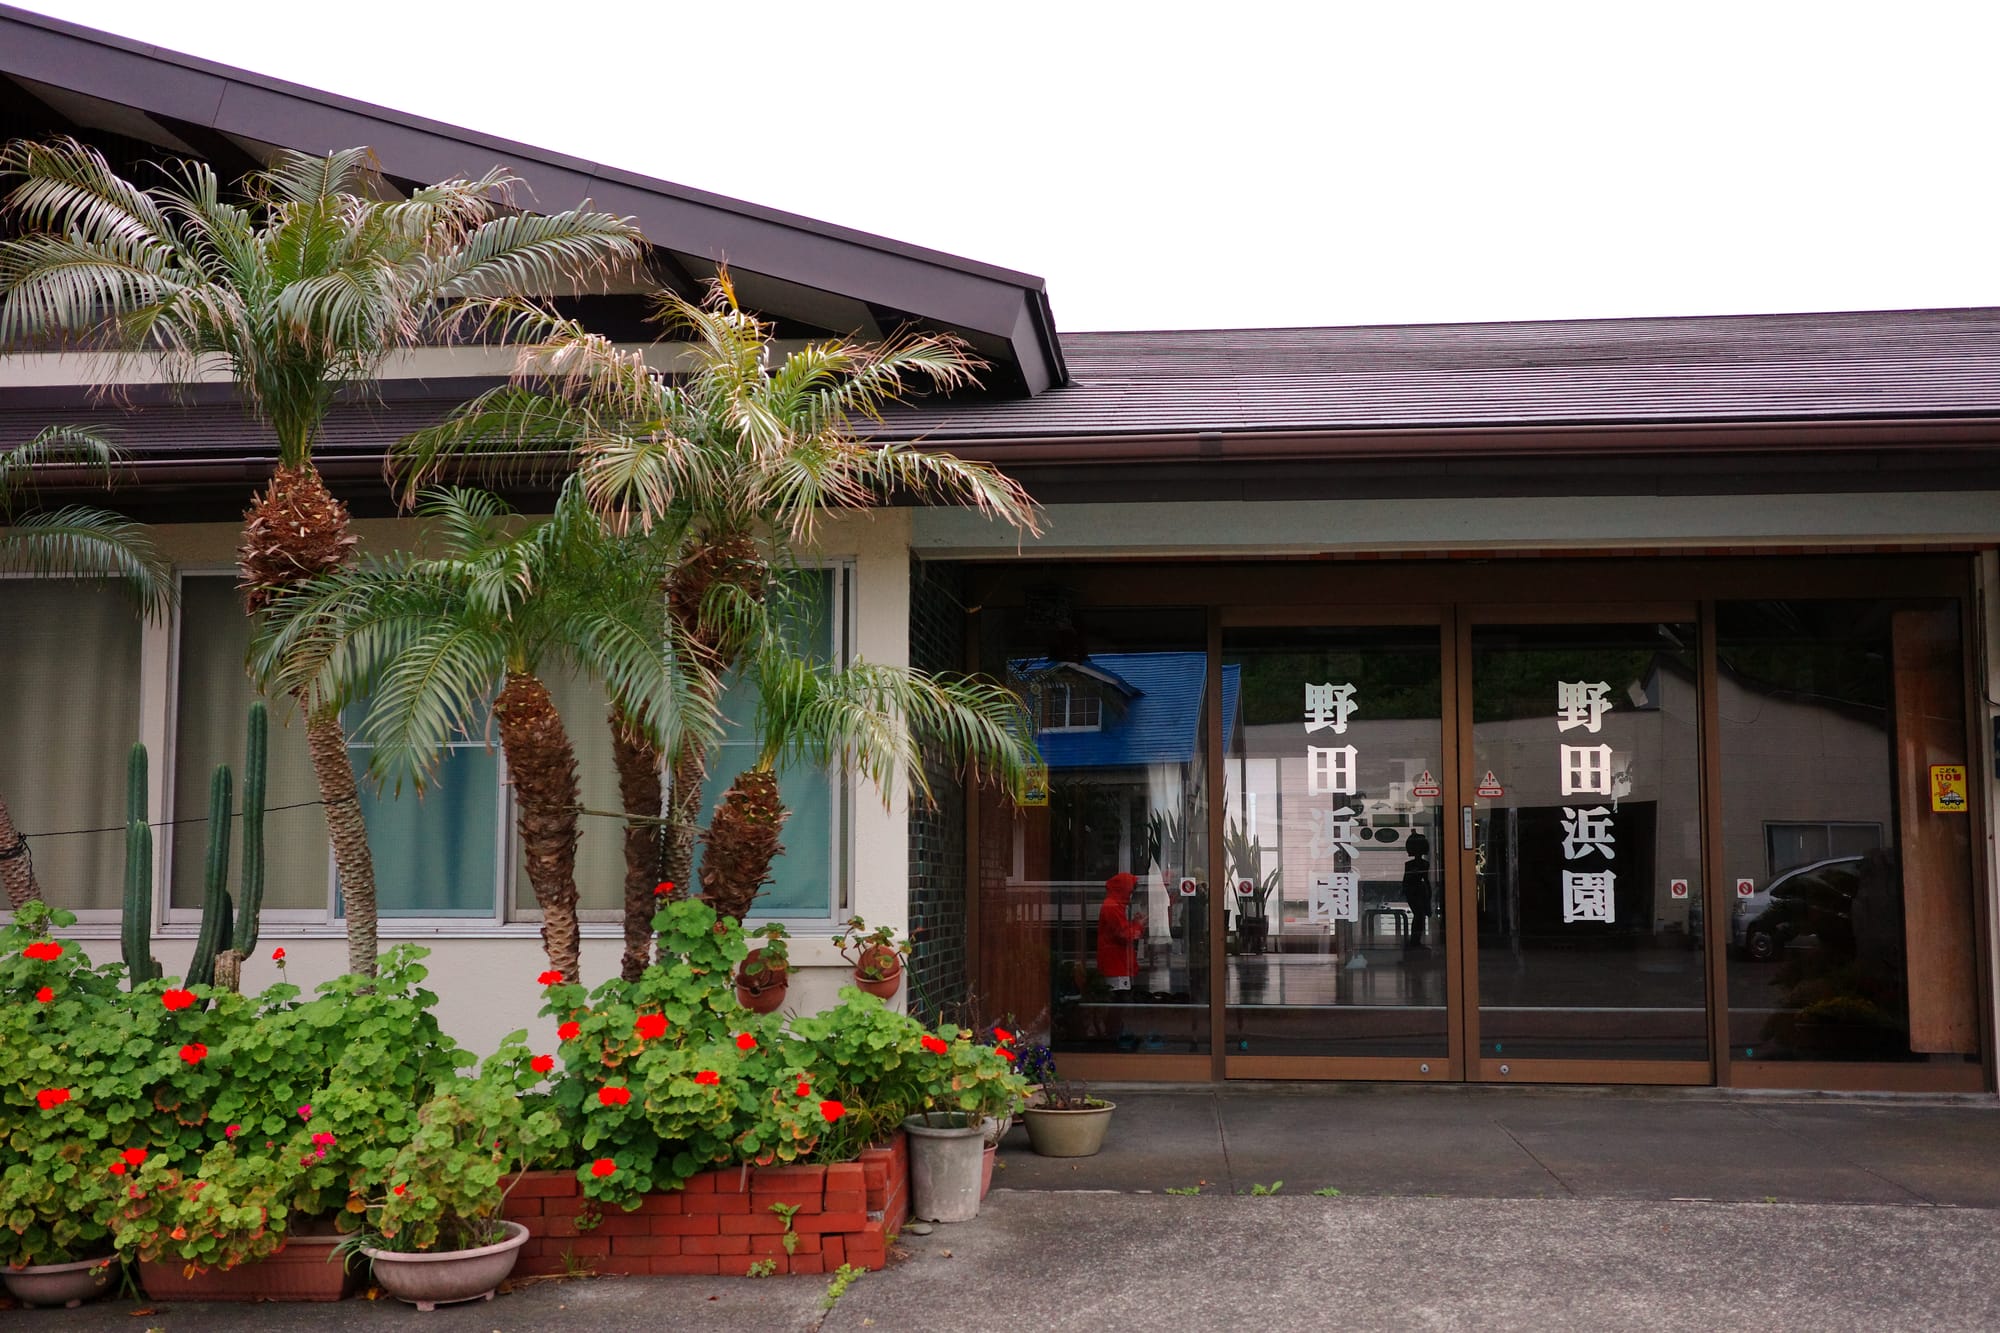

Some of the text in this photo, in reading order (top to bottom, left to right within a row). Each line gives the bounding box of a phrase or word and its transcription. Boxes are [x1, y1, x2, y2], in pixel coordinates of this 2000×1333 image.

[1304, 682, 1360, 923] 野田浜園
[1557, 680, 1617, 924] 野田浜園
